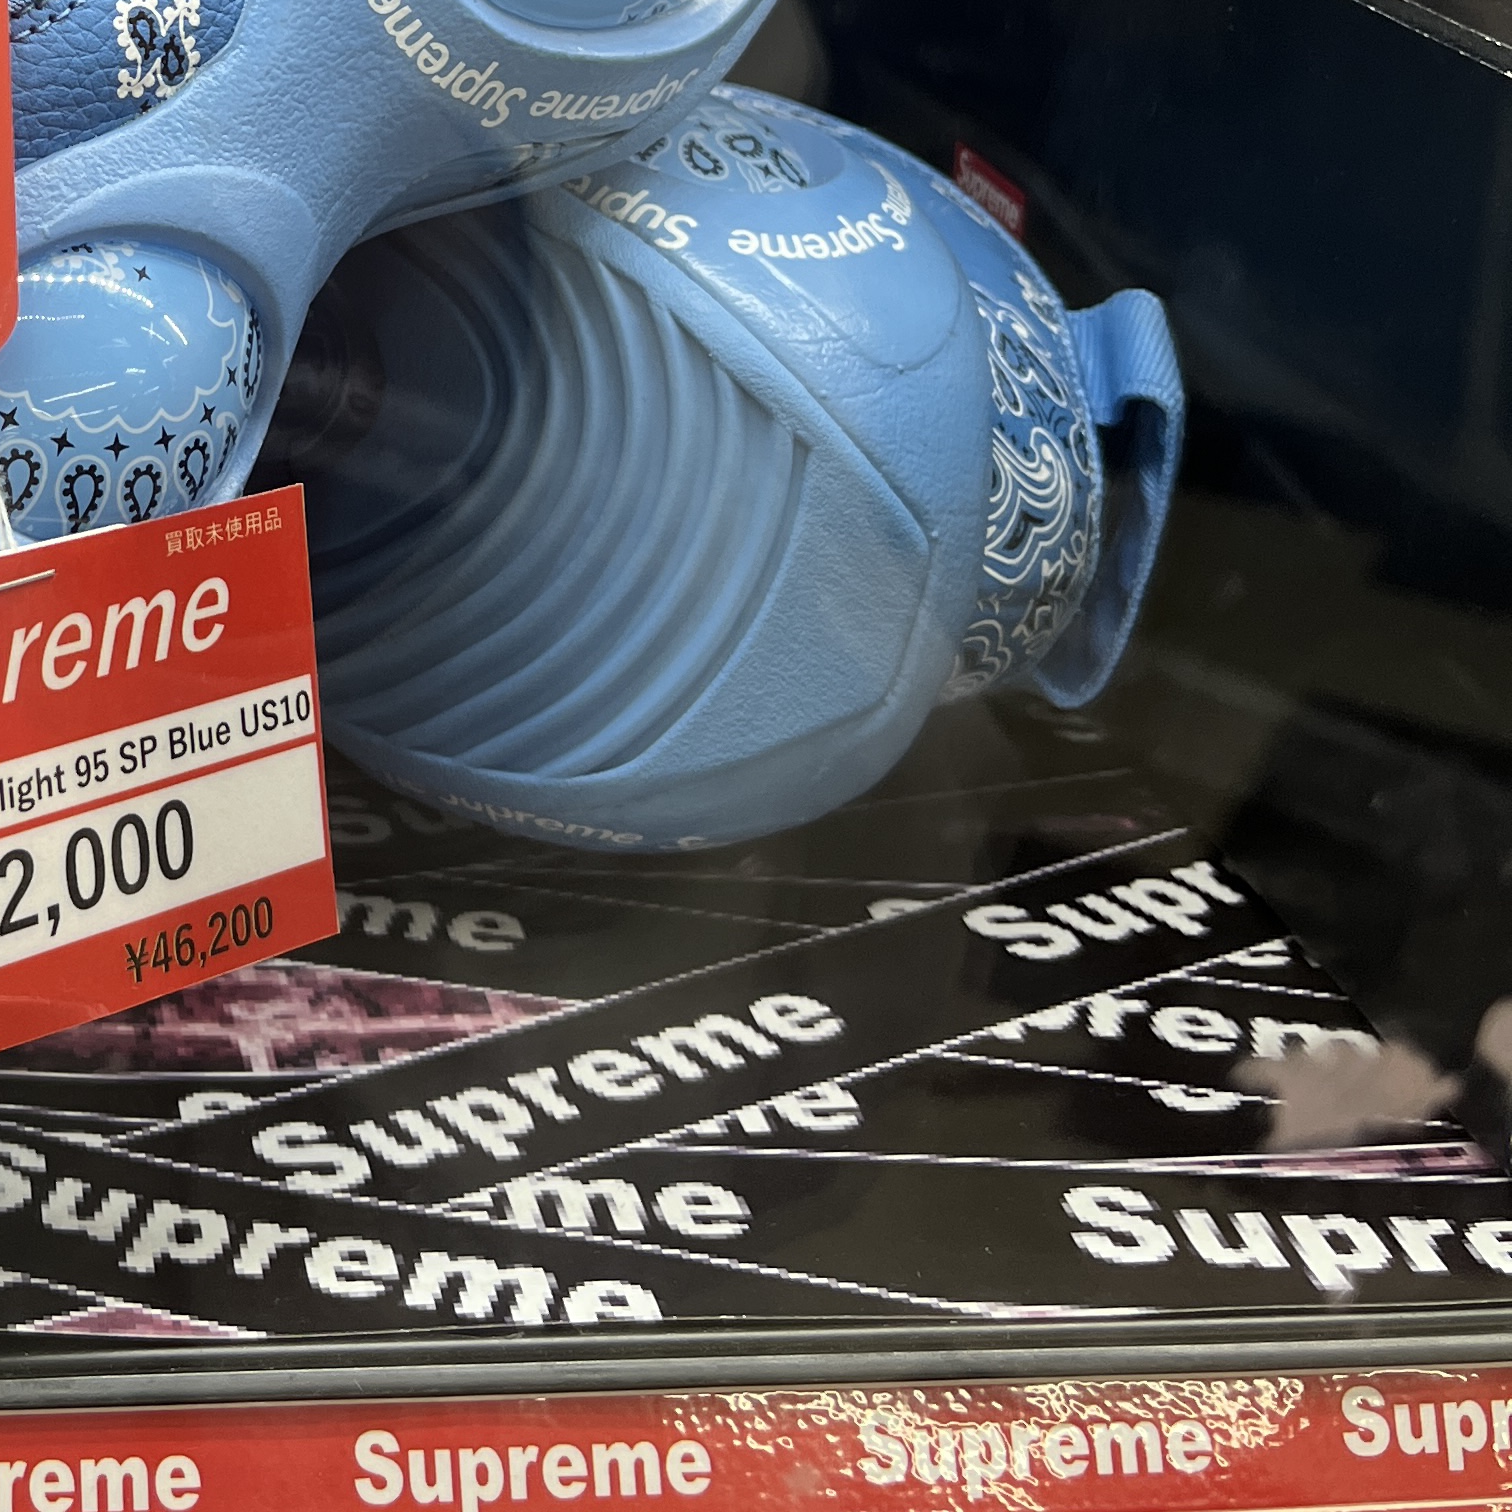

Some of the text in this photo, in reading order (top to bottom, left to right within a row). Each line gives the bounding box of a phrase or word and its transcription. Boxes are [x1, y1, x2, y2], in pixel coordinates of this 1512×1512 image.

[727, 212, 907, 261] Supreme
[164, 505, 284, 558] 買取未使用品
[74, 746, 111, 790] 95
[118, 734, 159, 776] SP
[168, 717, 232, 760] Blue
[240, 690, 312, 741] US10
[124, 897, 275, 985] ¥46,200
[962, 859, 1248, 961] Supr
[252, 993, 847, 1196] Supreme
[353, 1429, 713, 1512] Supreme
[858, 1413, 1214, 1502] Supreme
